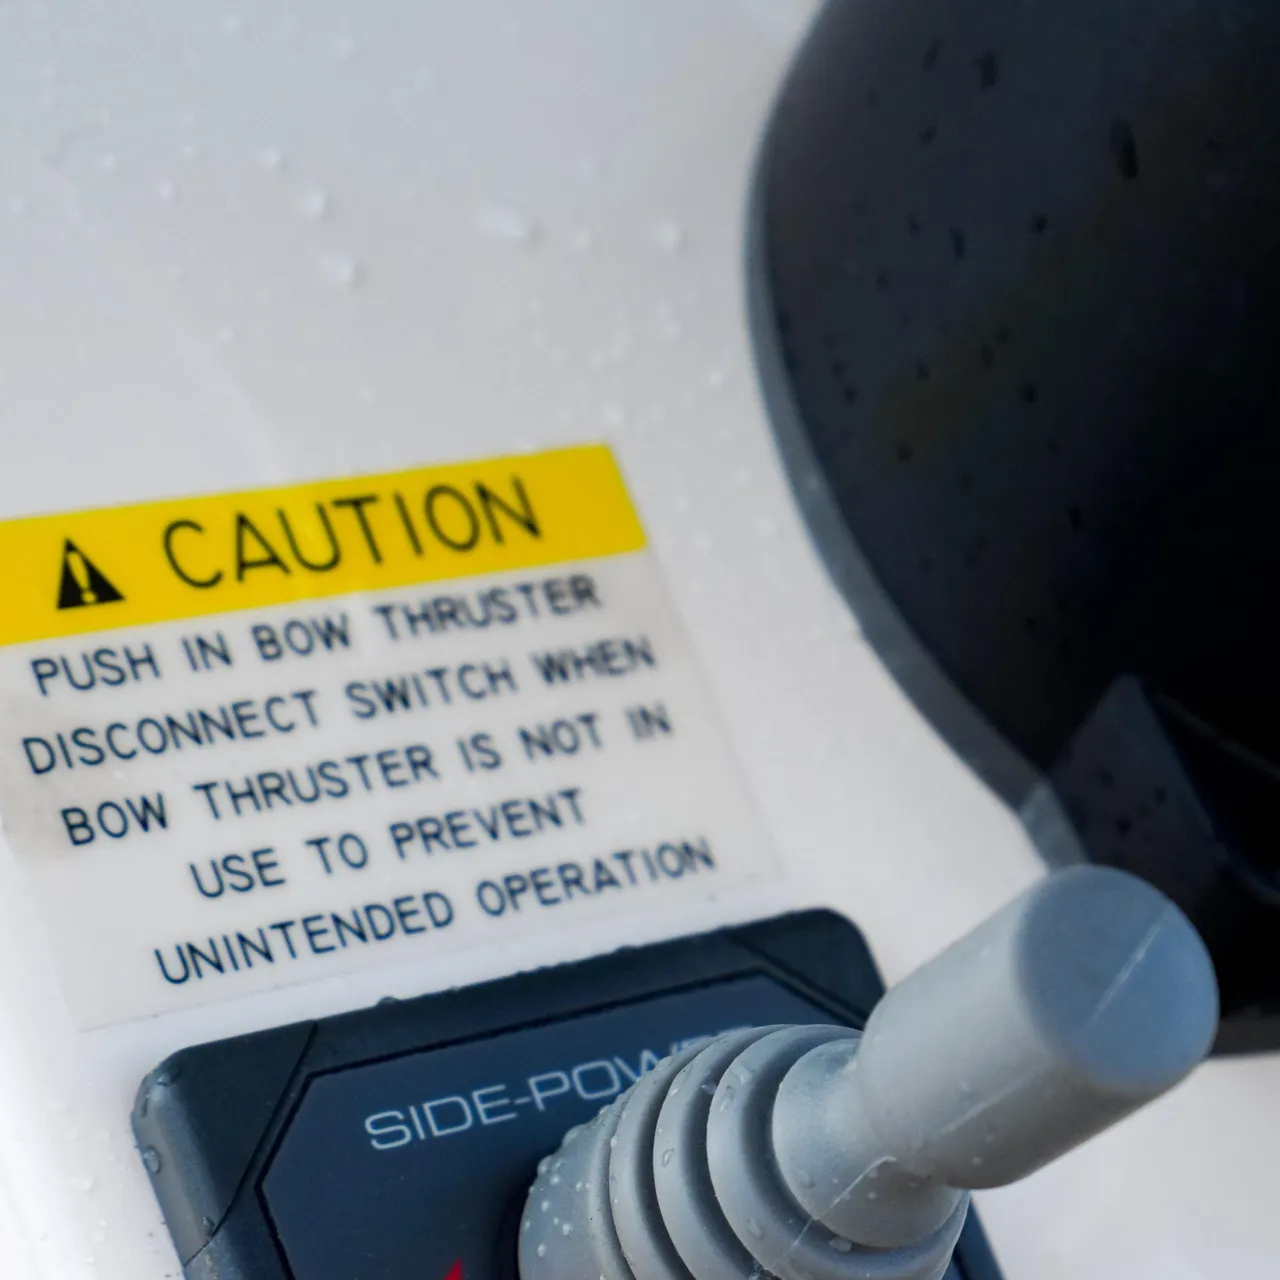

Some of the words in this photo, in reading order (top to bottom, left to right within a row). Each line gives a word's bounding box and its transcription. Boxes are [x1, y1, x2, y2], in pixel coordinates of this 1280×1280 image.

[161, 476, 543, 591] CAUTION
[29, 640, 161, 698] PUSH
[181, 633, 233, 672] IN
[251, 614, 351, 663] BOW
[373, 573, 601, 639] THRUSTER
[20, 689, 318, 777] DISCONNECT
[344, 663, 517, 720] SWITCH
[535, 639, 656, 686] WHEN
[59, 790, 169, 848] BOW
[191, 744, 439, 821] THRUSTER
[457, 732, 503, 772] IS
[517, 712, 601, 760] NOT
[627, 706, 672, 738] IN
[188, 846, 287, 900] USE
[305, 831, 370, 875] TO
[388, 787, 582, 860] PREVENT
[153, 890, 455, 986] UNINTENDED
[475, 838, 716, 918] OPERATION
